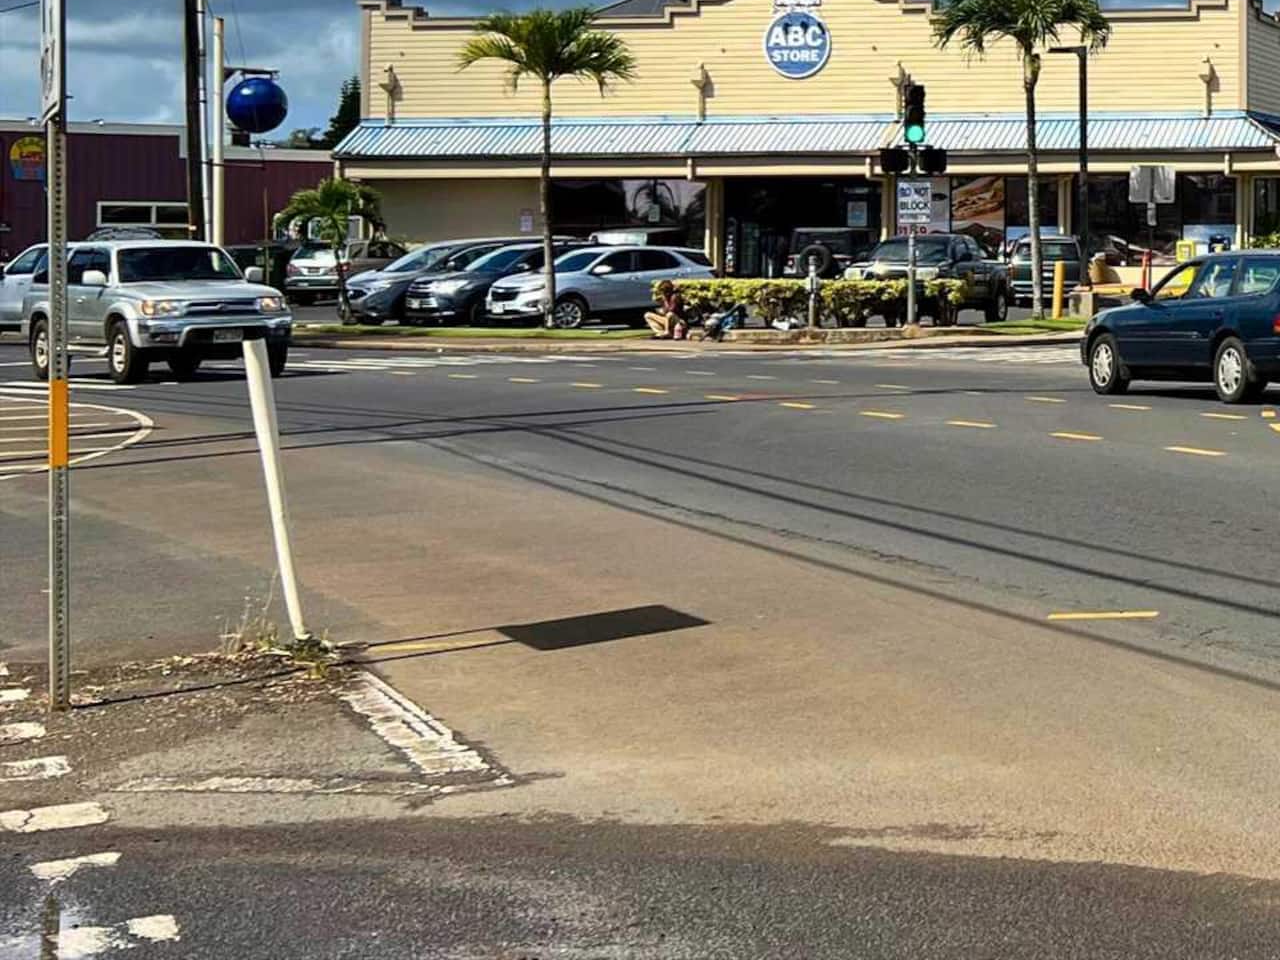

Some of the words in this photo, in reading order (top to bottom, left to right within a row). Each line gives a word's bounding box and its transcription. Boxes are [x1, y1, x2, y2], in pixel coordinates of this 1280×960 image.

[768, 25, 823, 47] ABC
[771, 49, 820, 62] STORE
[900, 200, 930, 210] BLOCK
